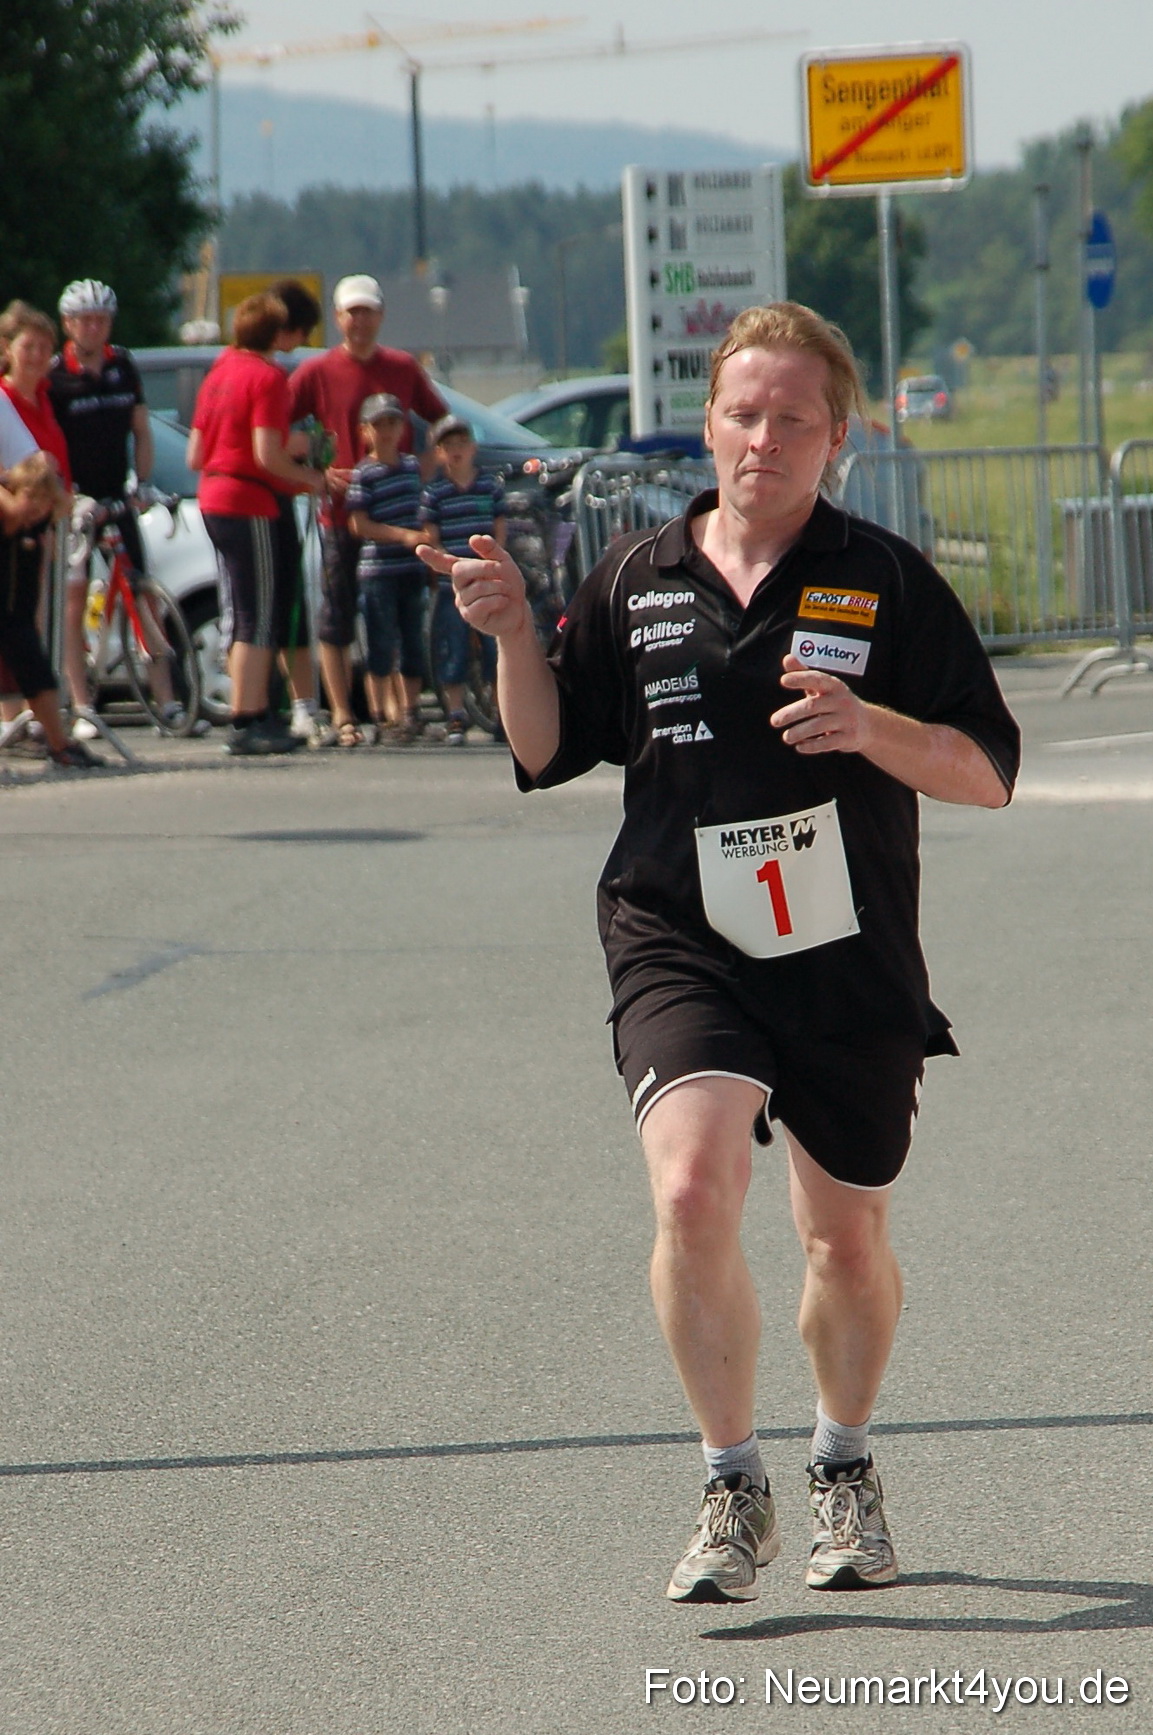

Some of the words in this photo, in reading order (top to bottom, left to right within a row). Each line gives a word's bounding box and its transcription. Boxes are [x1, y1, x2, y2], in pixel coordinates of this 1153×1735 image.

[628, 590, 695, 611] Cellagon
[847, 596, 876, 609] BRIEF
[643, 622, 694, 643] killtec
[817, 644, 860, 664] victory
[644, 674, 699, 699] AMADEUS
[652, 723, 692, 739] dmension
[672, 732, 693, 744] data
[720, 824, 785, 847] MEYER
[721, 840, 789, 859] WERBUNG
[756, 859, 793, 937] 1
